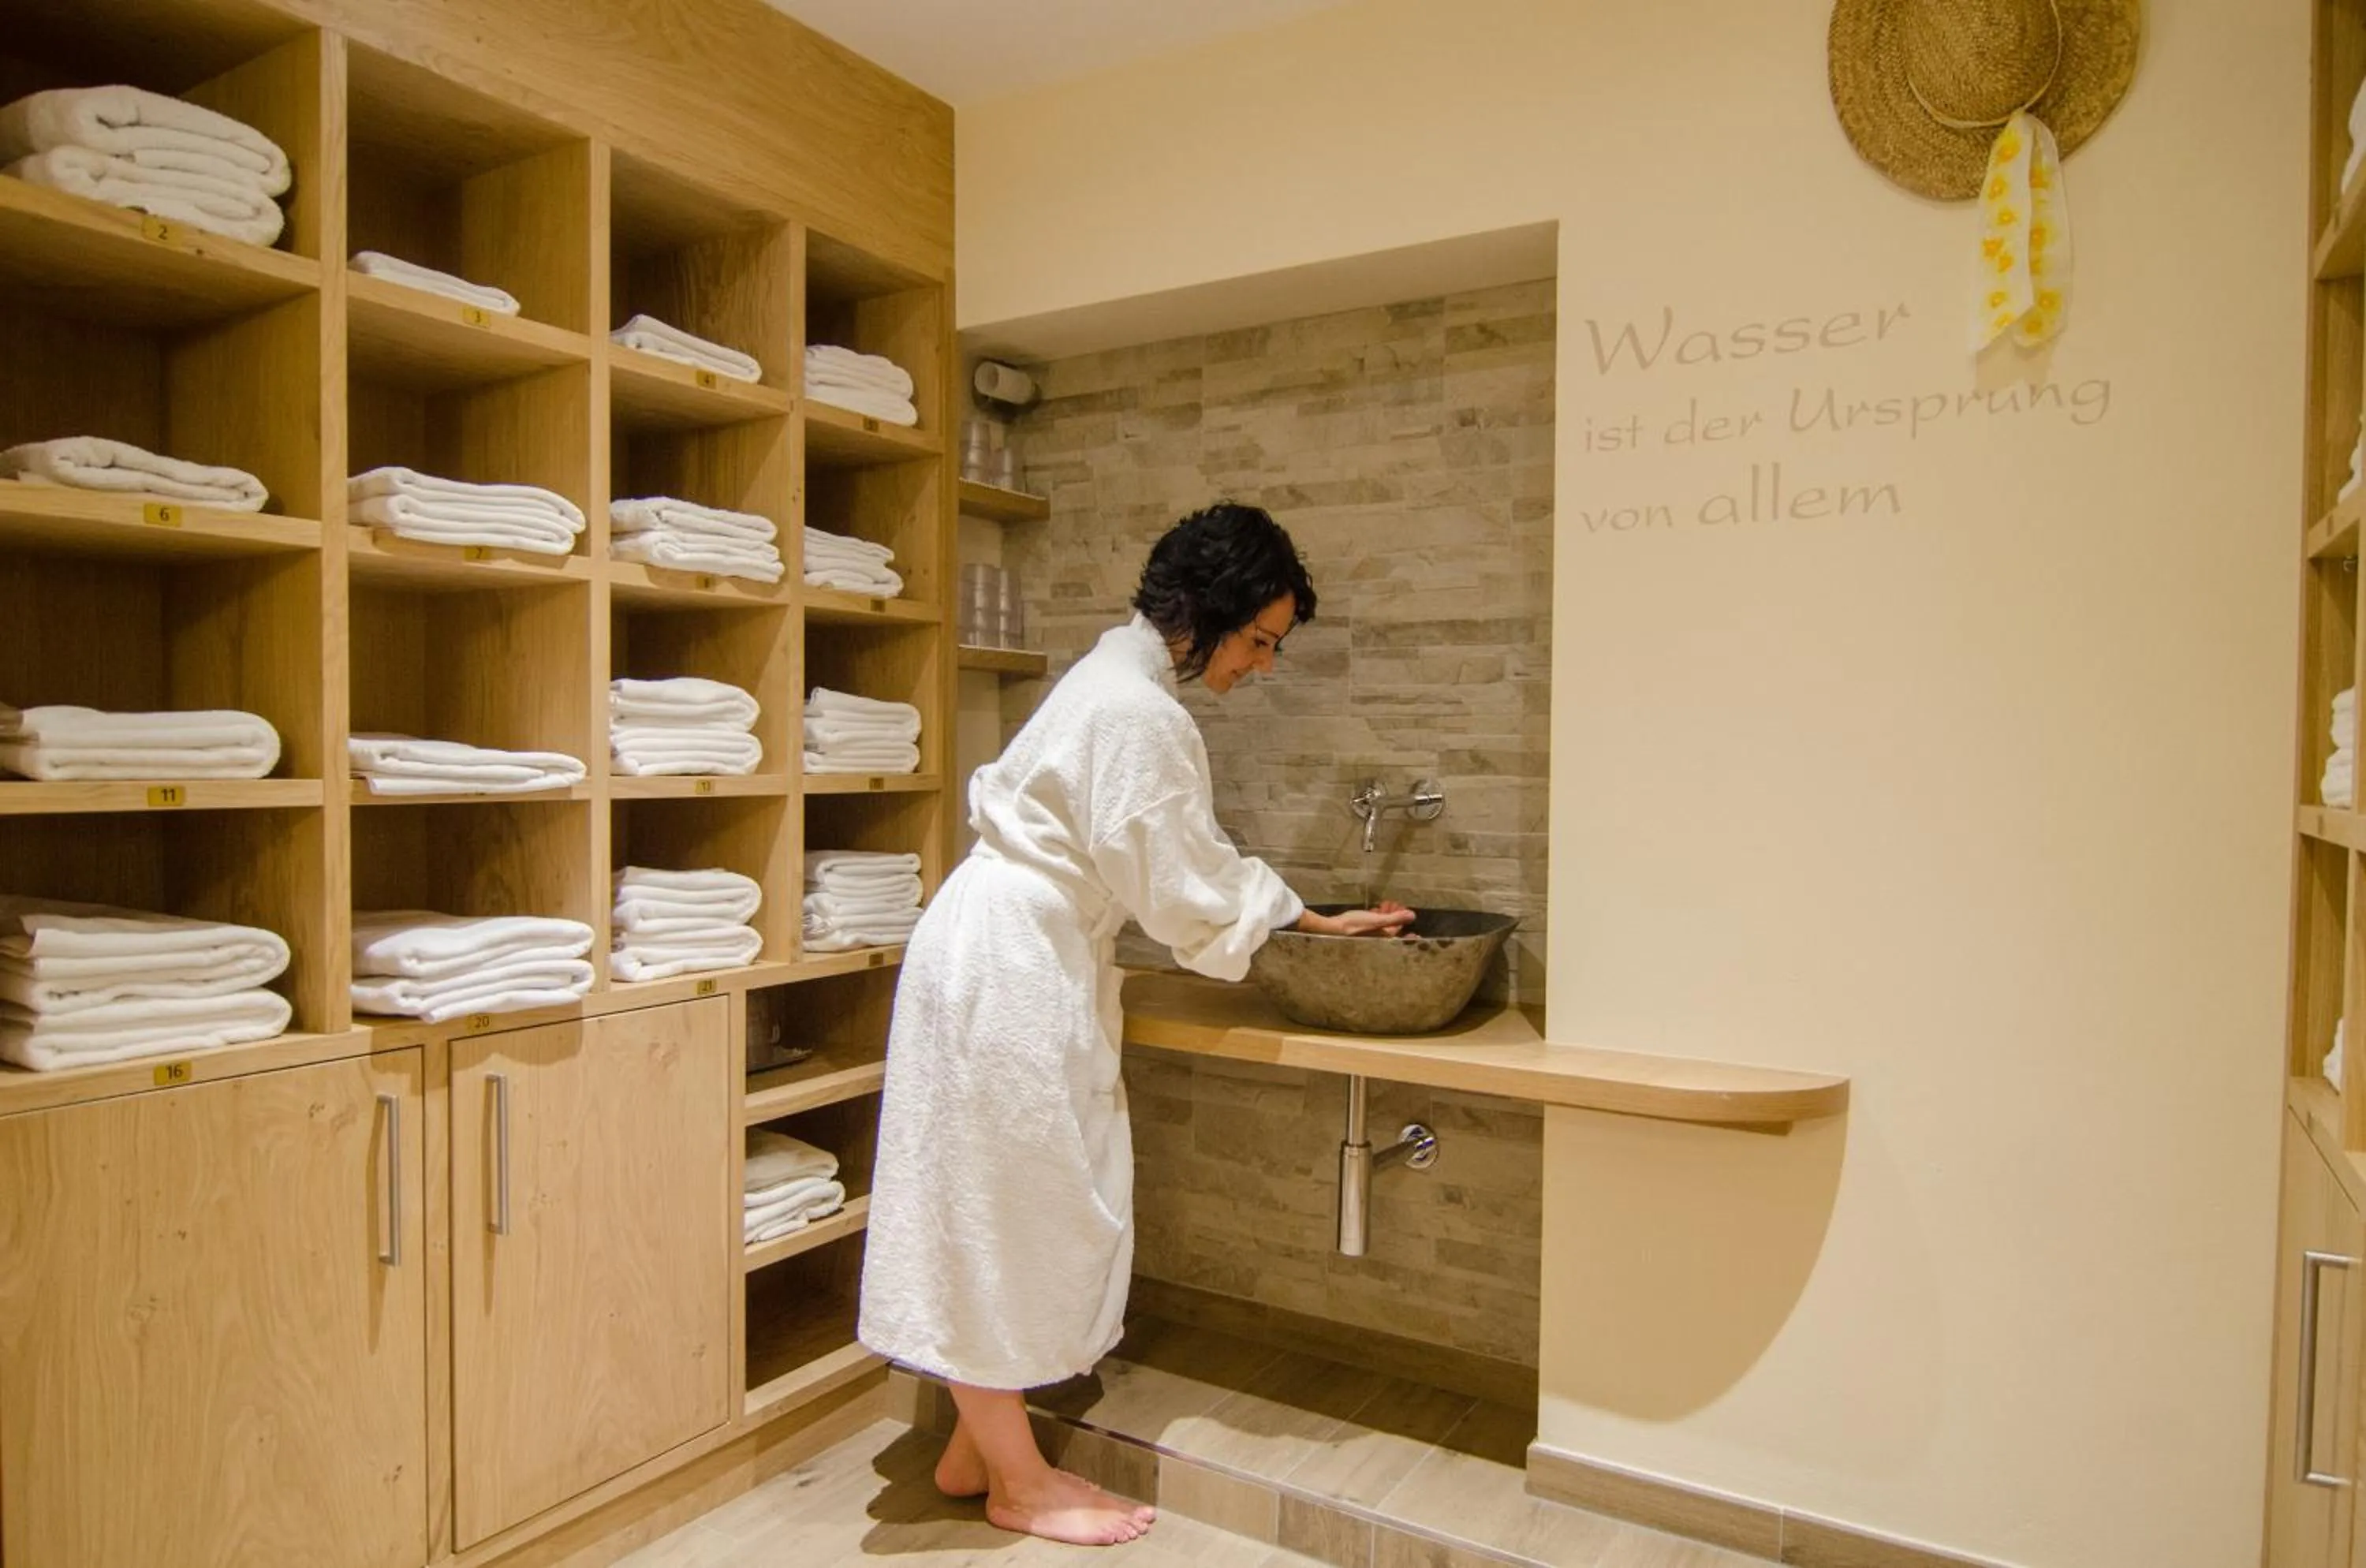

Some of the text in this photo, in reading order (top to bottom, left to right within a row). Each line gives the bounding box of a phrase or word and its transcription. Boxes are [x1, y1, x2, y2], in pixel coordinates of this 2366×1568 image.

[158, 225, 168, 241] 2
[1584, 302, 1912, 375] Wasser
[1584, 378, 2111, 453] ist der Ursprung
[1580, 461, 1902, 534] von allem
[159, 507, 170, 521] 6
[161, 788, 176, 802] 11
[475, 1015, 491, 1029] 20
[166, 1064, 183, 1080] 16
